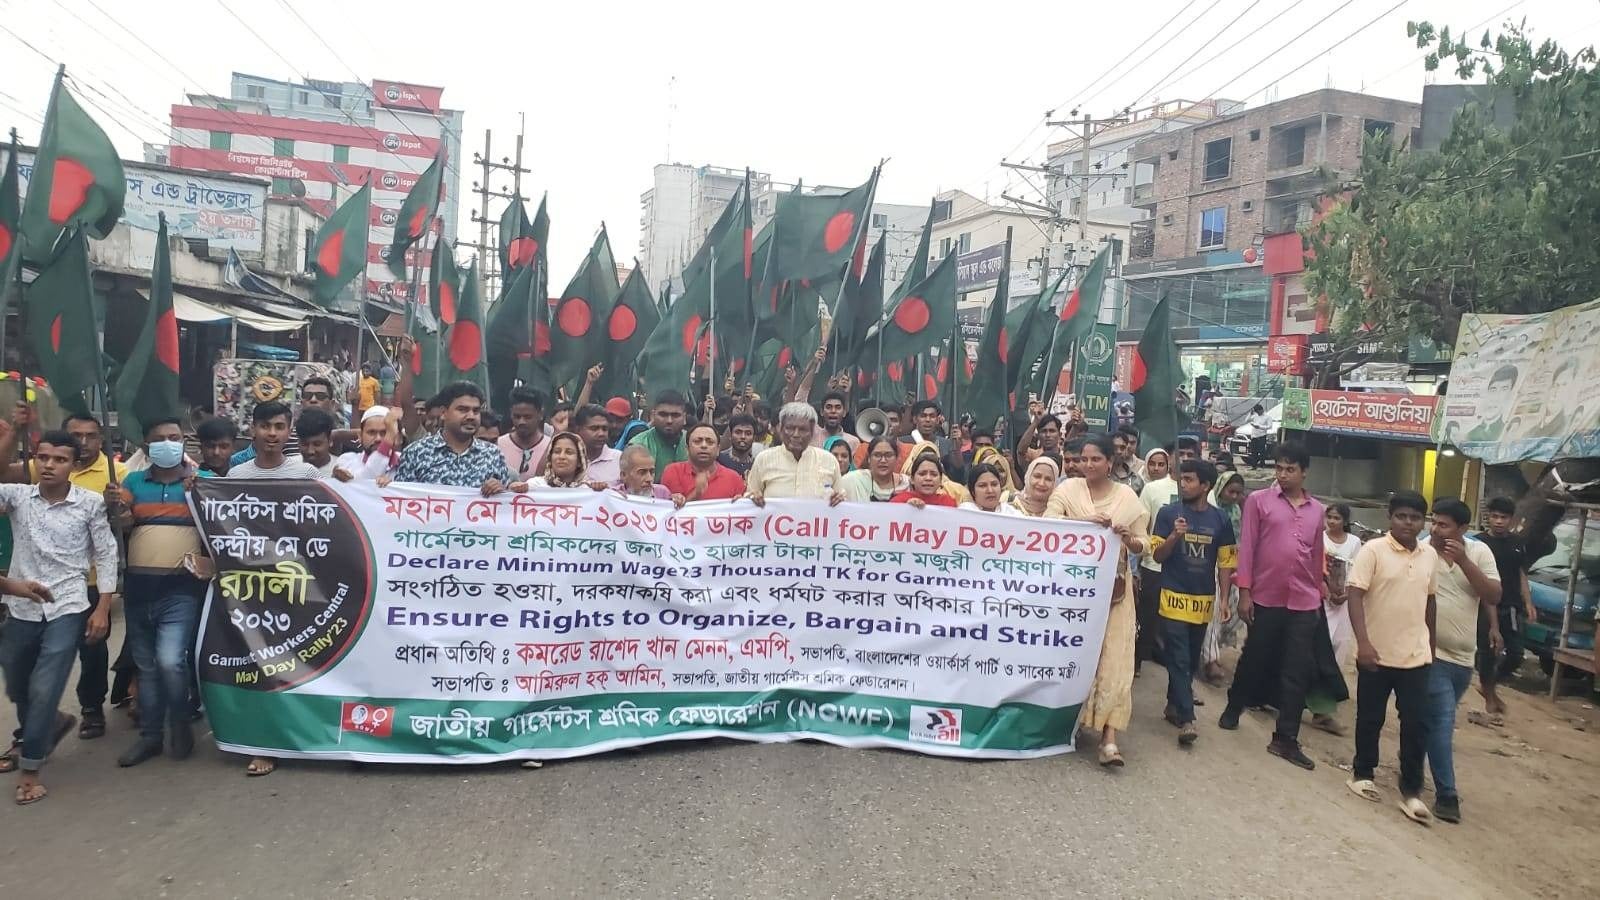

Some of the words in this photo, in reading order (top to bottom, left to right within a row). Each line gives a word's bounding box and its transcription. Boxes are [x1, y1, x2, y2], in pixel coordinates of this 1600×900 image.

[1076, 394, 1108, 412] ATM
[1314, 396, 1361, 418] হোটেল
[1364, 398, 1432, 424] আশুলিয়া
[282, 495, 340, 525] শ্রমিক
[382, 496, 456, 524] মহান
[467, 500, 502, 524] মে
[512, 494, 658, 534] দিবস-২০২৩
[665, 516, 696, 537] এর
[704, 513, 756, 536] ডাক
[764, 515, 828, 540] (Call
[838, 518, 880, 540] for
[889, 522, 948, 550] May
[958, 527, 1107, 562] Day-2023)
[275, 535, 300, 558] মে
[306, 536, 331, 558] ডে
[394, 528, 500, 551] গার্মেন্টস
[508, 531, 620, 555] শ্রমিকদের
[624, 539, 664, 560] জন্য
[669, 546, 696, 562] ২৩
[704, 543, 767, 562] হাজার
[774, 541, 824, 562] টাকা
[832, 543, 903, 566] নিম্নতম
[913, 550, 974, 574] মজুরী
[982, 556, 1055, 578] ঘোষণা
[1062, 564, 1099, 580] কর
[388, 553, 489, 571] Declare
[497, 556, 614, 574] Minimum
[621, 561, 678, 579] Wage
[708, 564, 816, 578] Thousand
[822, 566, 850, 580] TK
[858, 567, 890, 582] for
[896, 571, 996, 591] Garment
[1002, 578, 1096, 598] Workers
[386, 574, 485, 599] সংগঠিত
[493, 582, 562, 606] হওয়া,
[572, 582, 673, 602] দরকষাকষি
[678, 587, 712, 604] করা
[720, 586, 760, 603] এবং
[769, 582, 826, 604] ধর্মঘট
[832, 589, 887, 607] করার
[894, 590, 974, 615] অধিকার
[982, 596, 1052, 620] নিশ্চিত
[1058, 606, 1090, 624] কর
[208, 653, 255, 666] Garment
[259, 626, 316, 661] Workers
[314, 582, 350, 626] Central
[230, 607, 291, 635] ২০২৩
[387, 606, 508, 628] Ensure
[519, 609, 615, 634] Rights
[622, 610, 650, 626] to
[658, 608, 796, 631] Organize,
[806, 610, 920, 636] Bargain
[930, 623, 988, 641] and
[998, 626, 1084, 648] Strike
[236, 670, 259, 684] May
[262, 658, 296, 678] Day
[395, 643, 438, 665] প্রধান
[444, 640, 498, 665] অতিথি
[515, 641, 584, 668] কমরেড
[590, 636, 640, 664] রাশেদ
[646, 634, 680, 662] খান
[685, 637, 734, 664] মেনন,
[740, 632, 794, 664] এমপি,
[800, 644, 850, 664] সভাপতি,
[855, 649, 921, 668] বাংলাদেশের
[926, 654, 970, 672] ওয়ার্কার্স
[975, 657, 1000, 676] পার্টি
[1004, 664, 1014, 677] ও
[1018, 664, 1056, 680] সাবেক
[431, 672, 496, 694] সভাপতি
[514, 670, 581, 695] আমিরুল
[616, 663, 666, 688] আমিন,
[672, 670, 720, 688] সভাপতি,
[724, 668, 759, 686] জাতীয়
[764, 668, 810, 687] গার্মেন্টস
[812, 669, 846, 686] শ্রমিক
[409, 706, 494, 740] জাতীয়
[503, 703, 593, 736] গার্মেন্টস
[598, 700, 662, 728] শ্রমিক
[668, 700, 780, 727] ফেডারেশন
